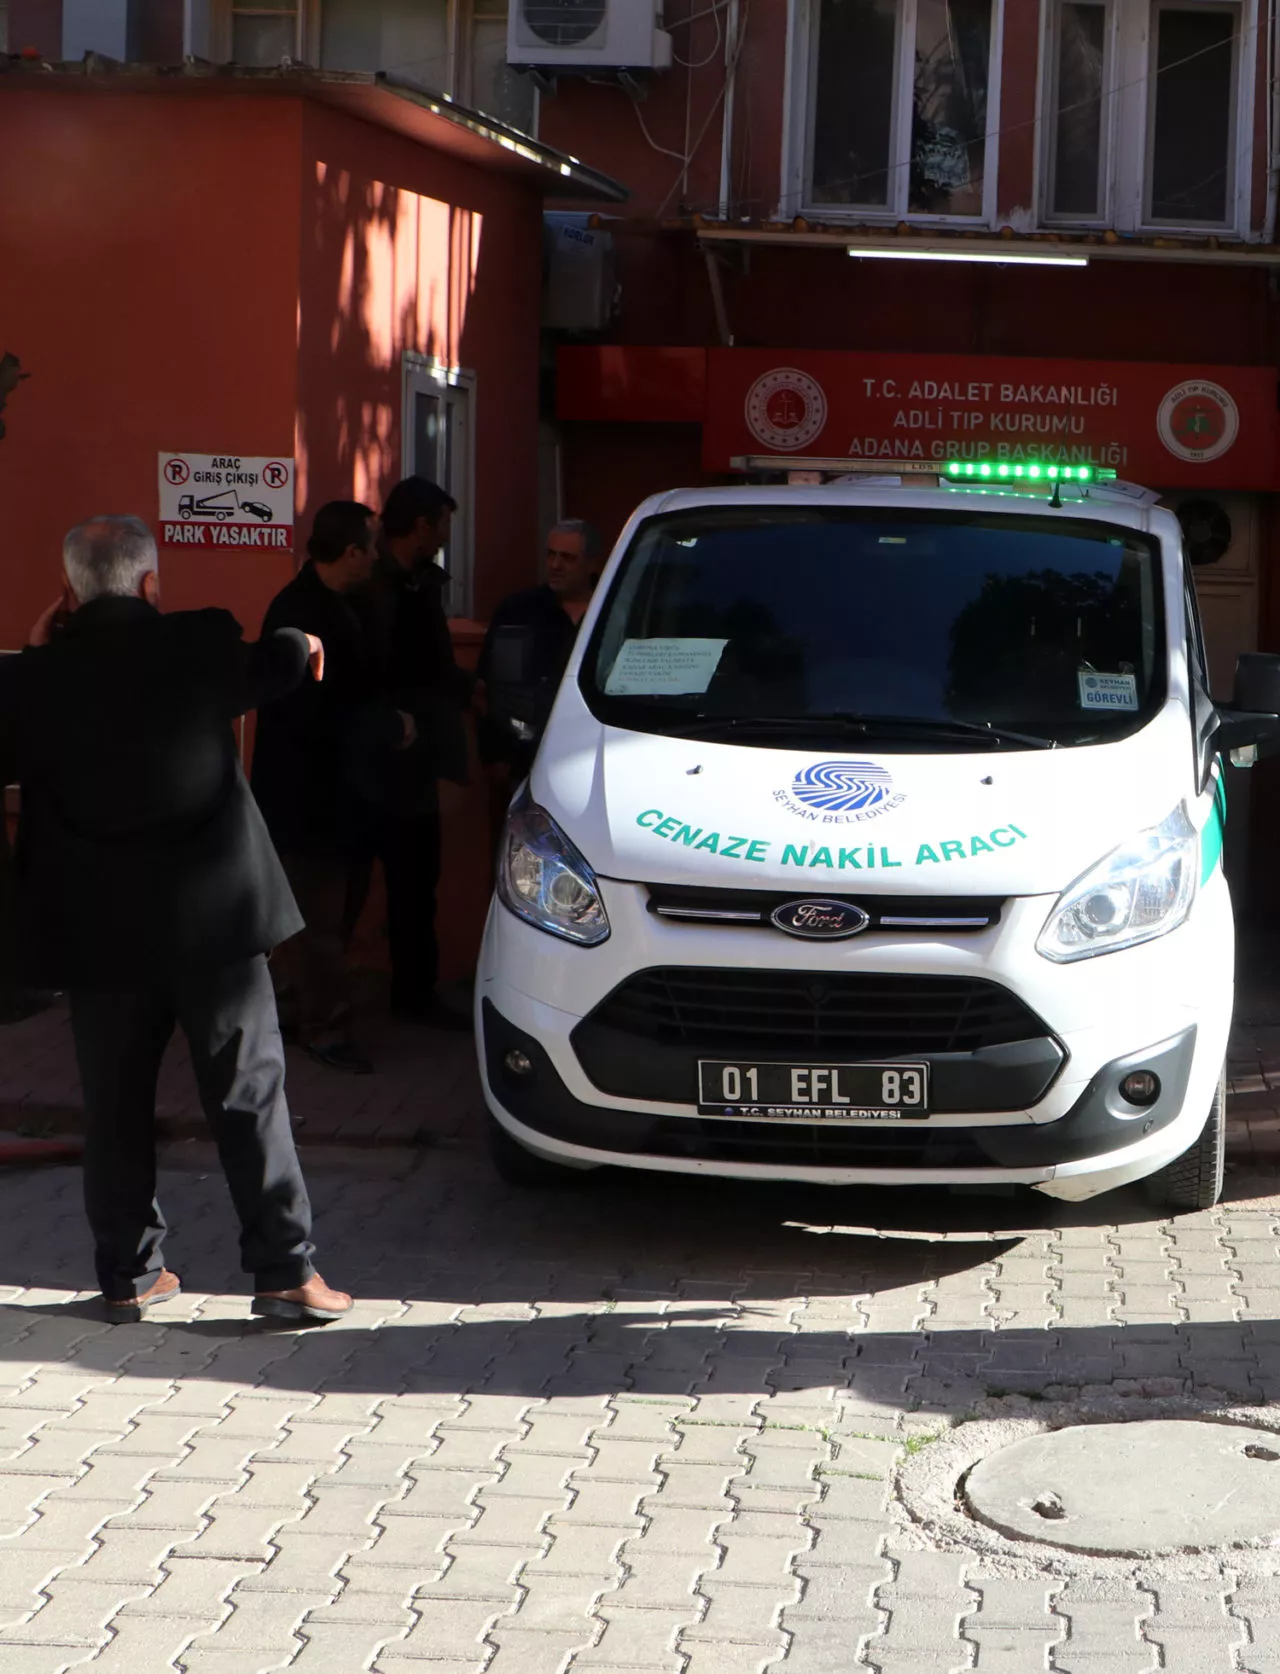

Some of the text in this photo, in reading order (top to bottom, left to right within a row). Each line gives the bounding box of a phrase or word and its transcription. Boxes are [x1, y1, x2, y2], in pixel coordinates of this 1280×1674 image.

[863, 379, 1117, 406] T.C. ADALET BAKANLIĞI
[893, 407, 1085, 434] ADLİ TIP KURUMU
[849, 438, 924, 457] ADANA
[930, 440, 990, 460] GRUP
[211, 457, 241, 472] ARAÇ
[225, 472, 259, 487] ÇIKIŞI
[164, 524, 288, 546] PARK YASAKTIR
[1086, 690, 1133, 705] GÖREVLİ
[772, 789, 820, 821] SEYHAN
[636, 809, 1028, 869] CENAZE NAKİL ARACI
[792, 905, 844, 930] Ford
[722, 1066, 920, 1105] 01 EFL 83
[740, 1107, 764, 1117] T.C.
[767, 1108, 822, 1118] SEYHAN
